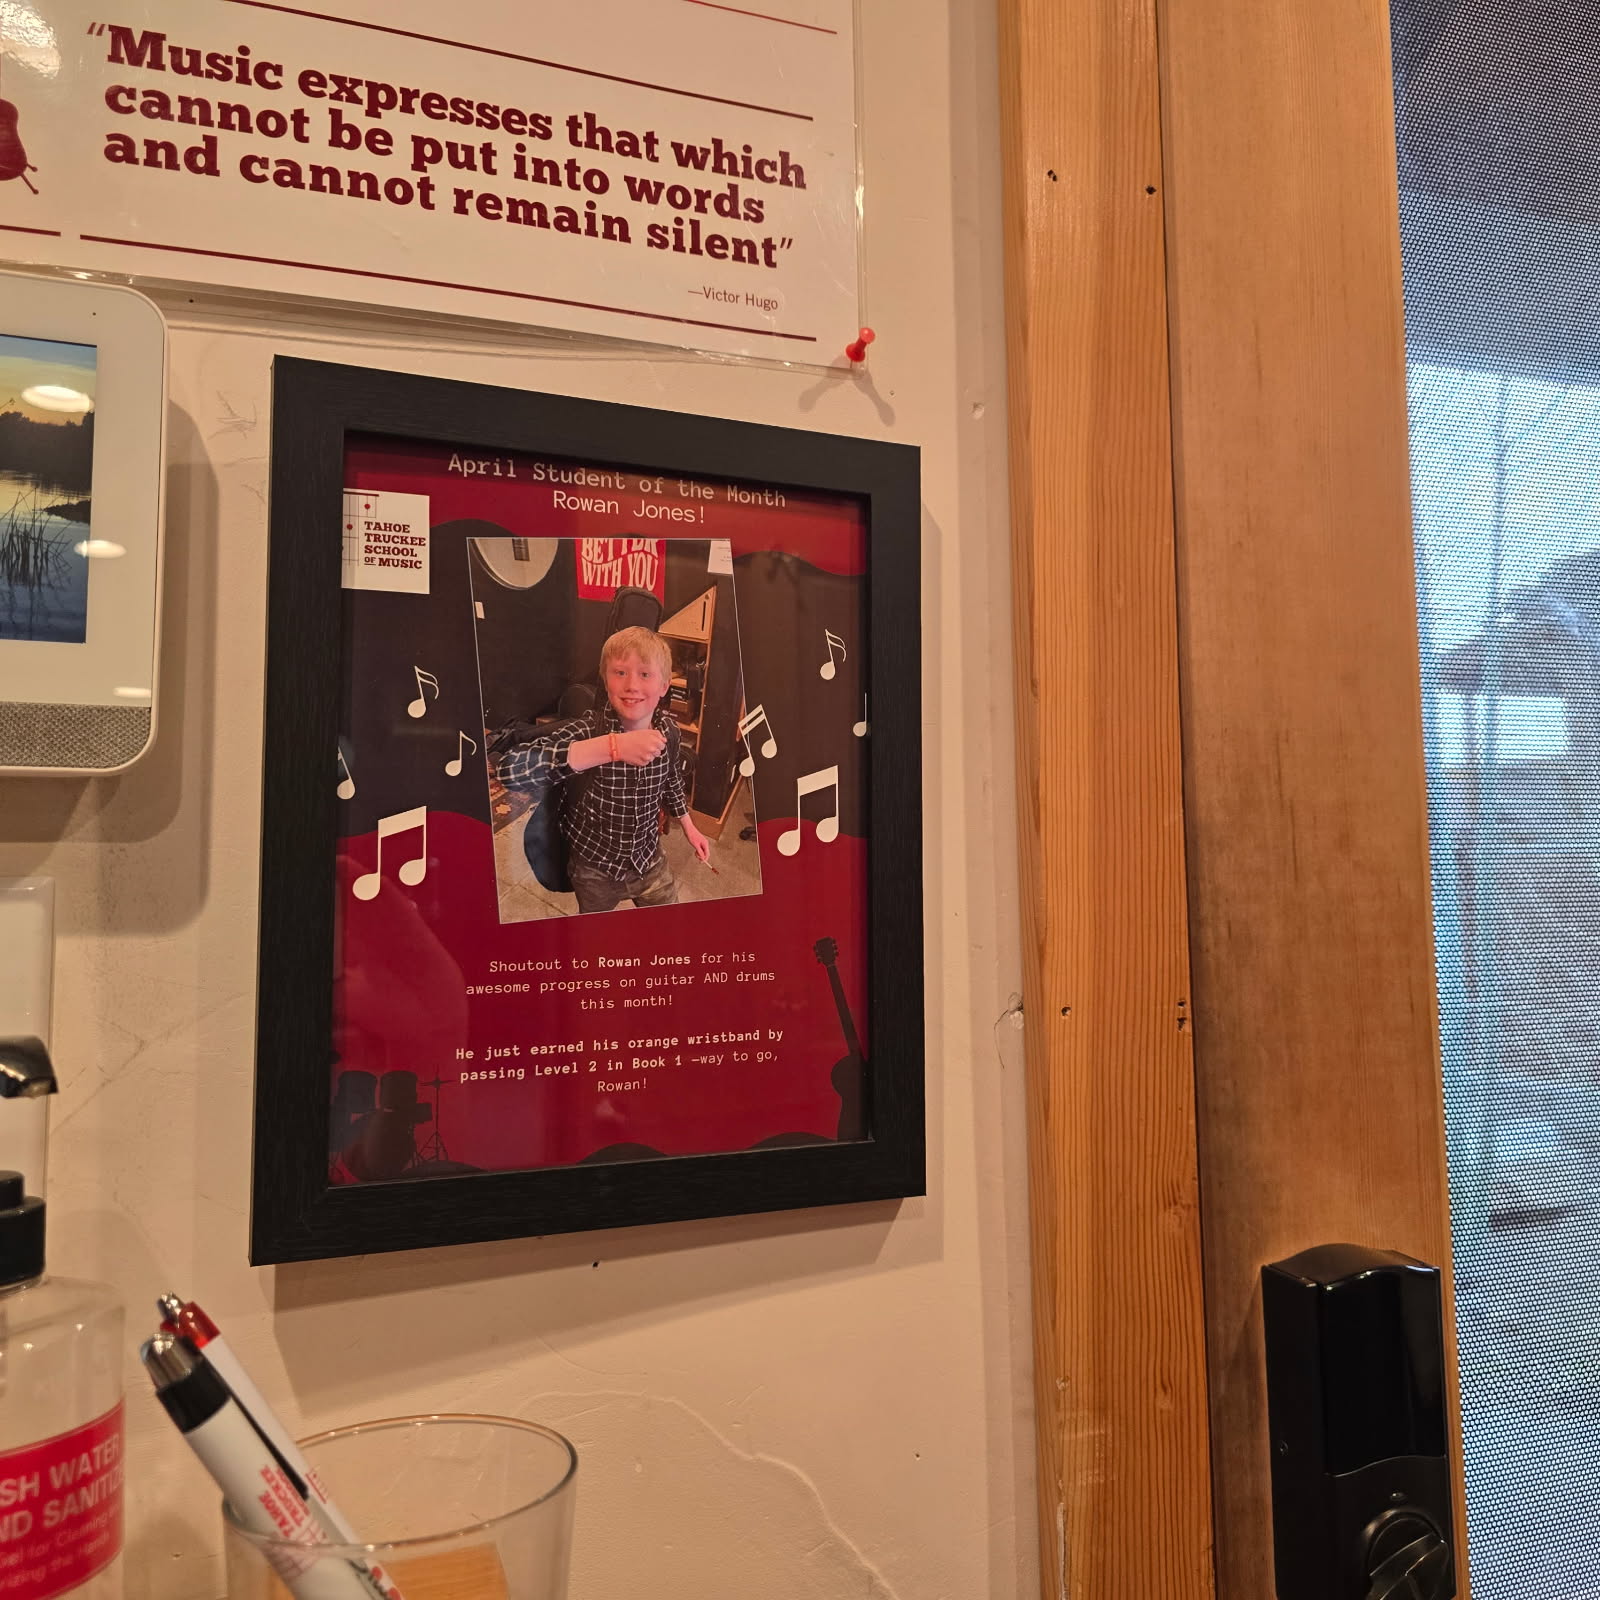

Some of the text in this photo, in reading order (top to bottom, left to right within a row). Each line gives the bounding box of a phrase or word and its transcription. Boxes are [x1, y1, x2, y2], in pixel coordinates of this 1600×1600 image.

[298, 69, 553, 141] expresses
[565, 111, 659, 163] that
[670, 137, 807, 189] which
[104, 85, 765, 224] cannot be put into words
[103, 133, 221, 177] and
[239, 154, 435, 211] cannot
[453, 187, 632, 244] remain
[745, 292, 779, 312] Hugo
[447, 453, 786, 508] April Student of the Month
[552, 489, 704, 524] Rowan Jones!
[364, 521, 411, 534] TAHOE
[364, 532, 427, 547] TRUCKEE
[364, 544, 418, 558] SCHOOL
[364, 556, 423, 570] OF MUSIC
[581, 551, 659, 592] WITH YOU
[489, 951, 756, 973] Shoutout to Rowan Jones for his
[466, 970, 775, 995] awesome progress on guitar AND drums
[580, 994, 673, 1010] this month!
[456, 1028, 784, 1061] He just earned his orange wristband by
[460, 1067, 525, 1084] passing
[535, 1062, 578, 1077] Level
[588, 1060, 598, 1072] 2
[607, 1059, 623, 1071] in
[632, 1055, 666, 1069] Book
[675, 1055, 682, 1066] 1
[733, 1051, 749, 1062] to
[756, 1050, 779, 1064] go,
[597, 1077, 648, 1092] Rowan!
